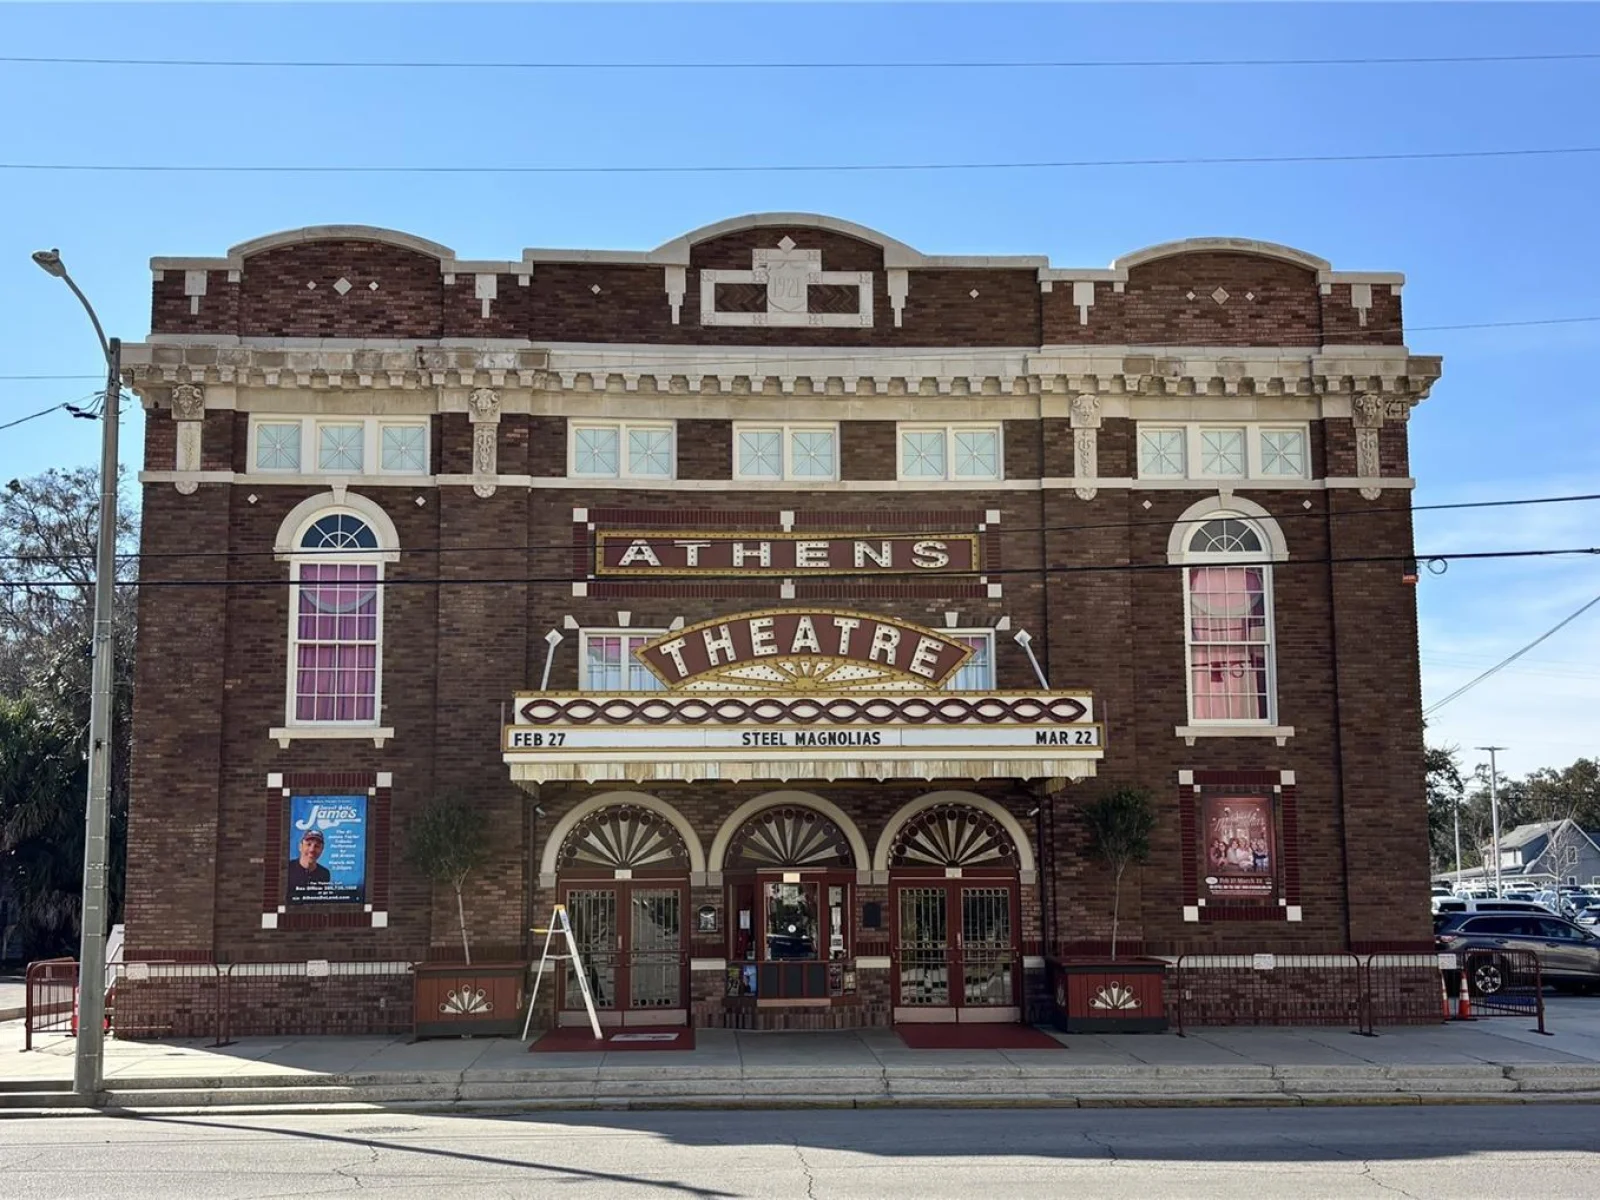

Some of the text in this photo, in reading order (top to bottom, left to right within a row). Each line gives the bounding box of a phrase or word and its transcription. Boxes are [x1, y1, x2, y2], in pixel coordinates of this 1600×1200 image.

[772, 276, 802, 298] 1921
[618, 539, 950, 568] ATHENS
[659, 615, 945, 678] THEATRE
[513, 732, 566, 746] FEB 27
[742, 731, 881, 746] STEEL MAGNOLIAS
[1035, 730, 1092, 745] MAR 22
[295, 805, 357, 830] James
